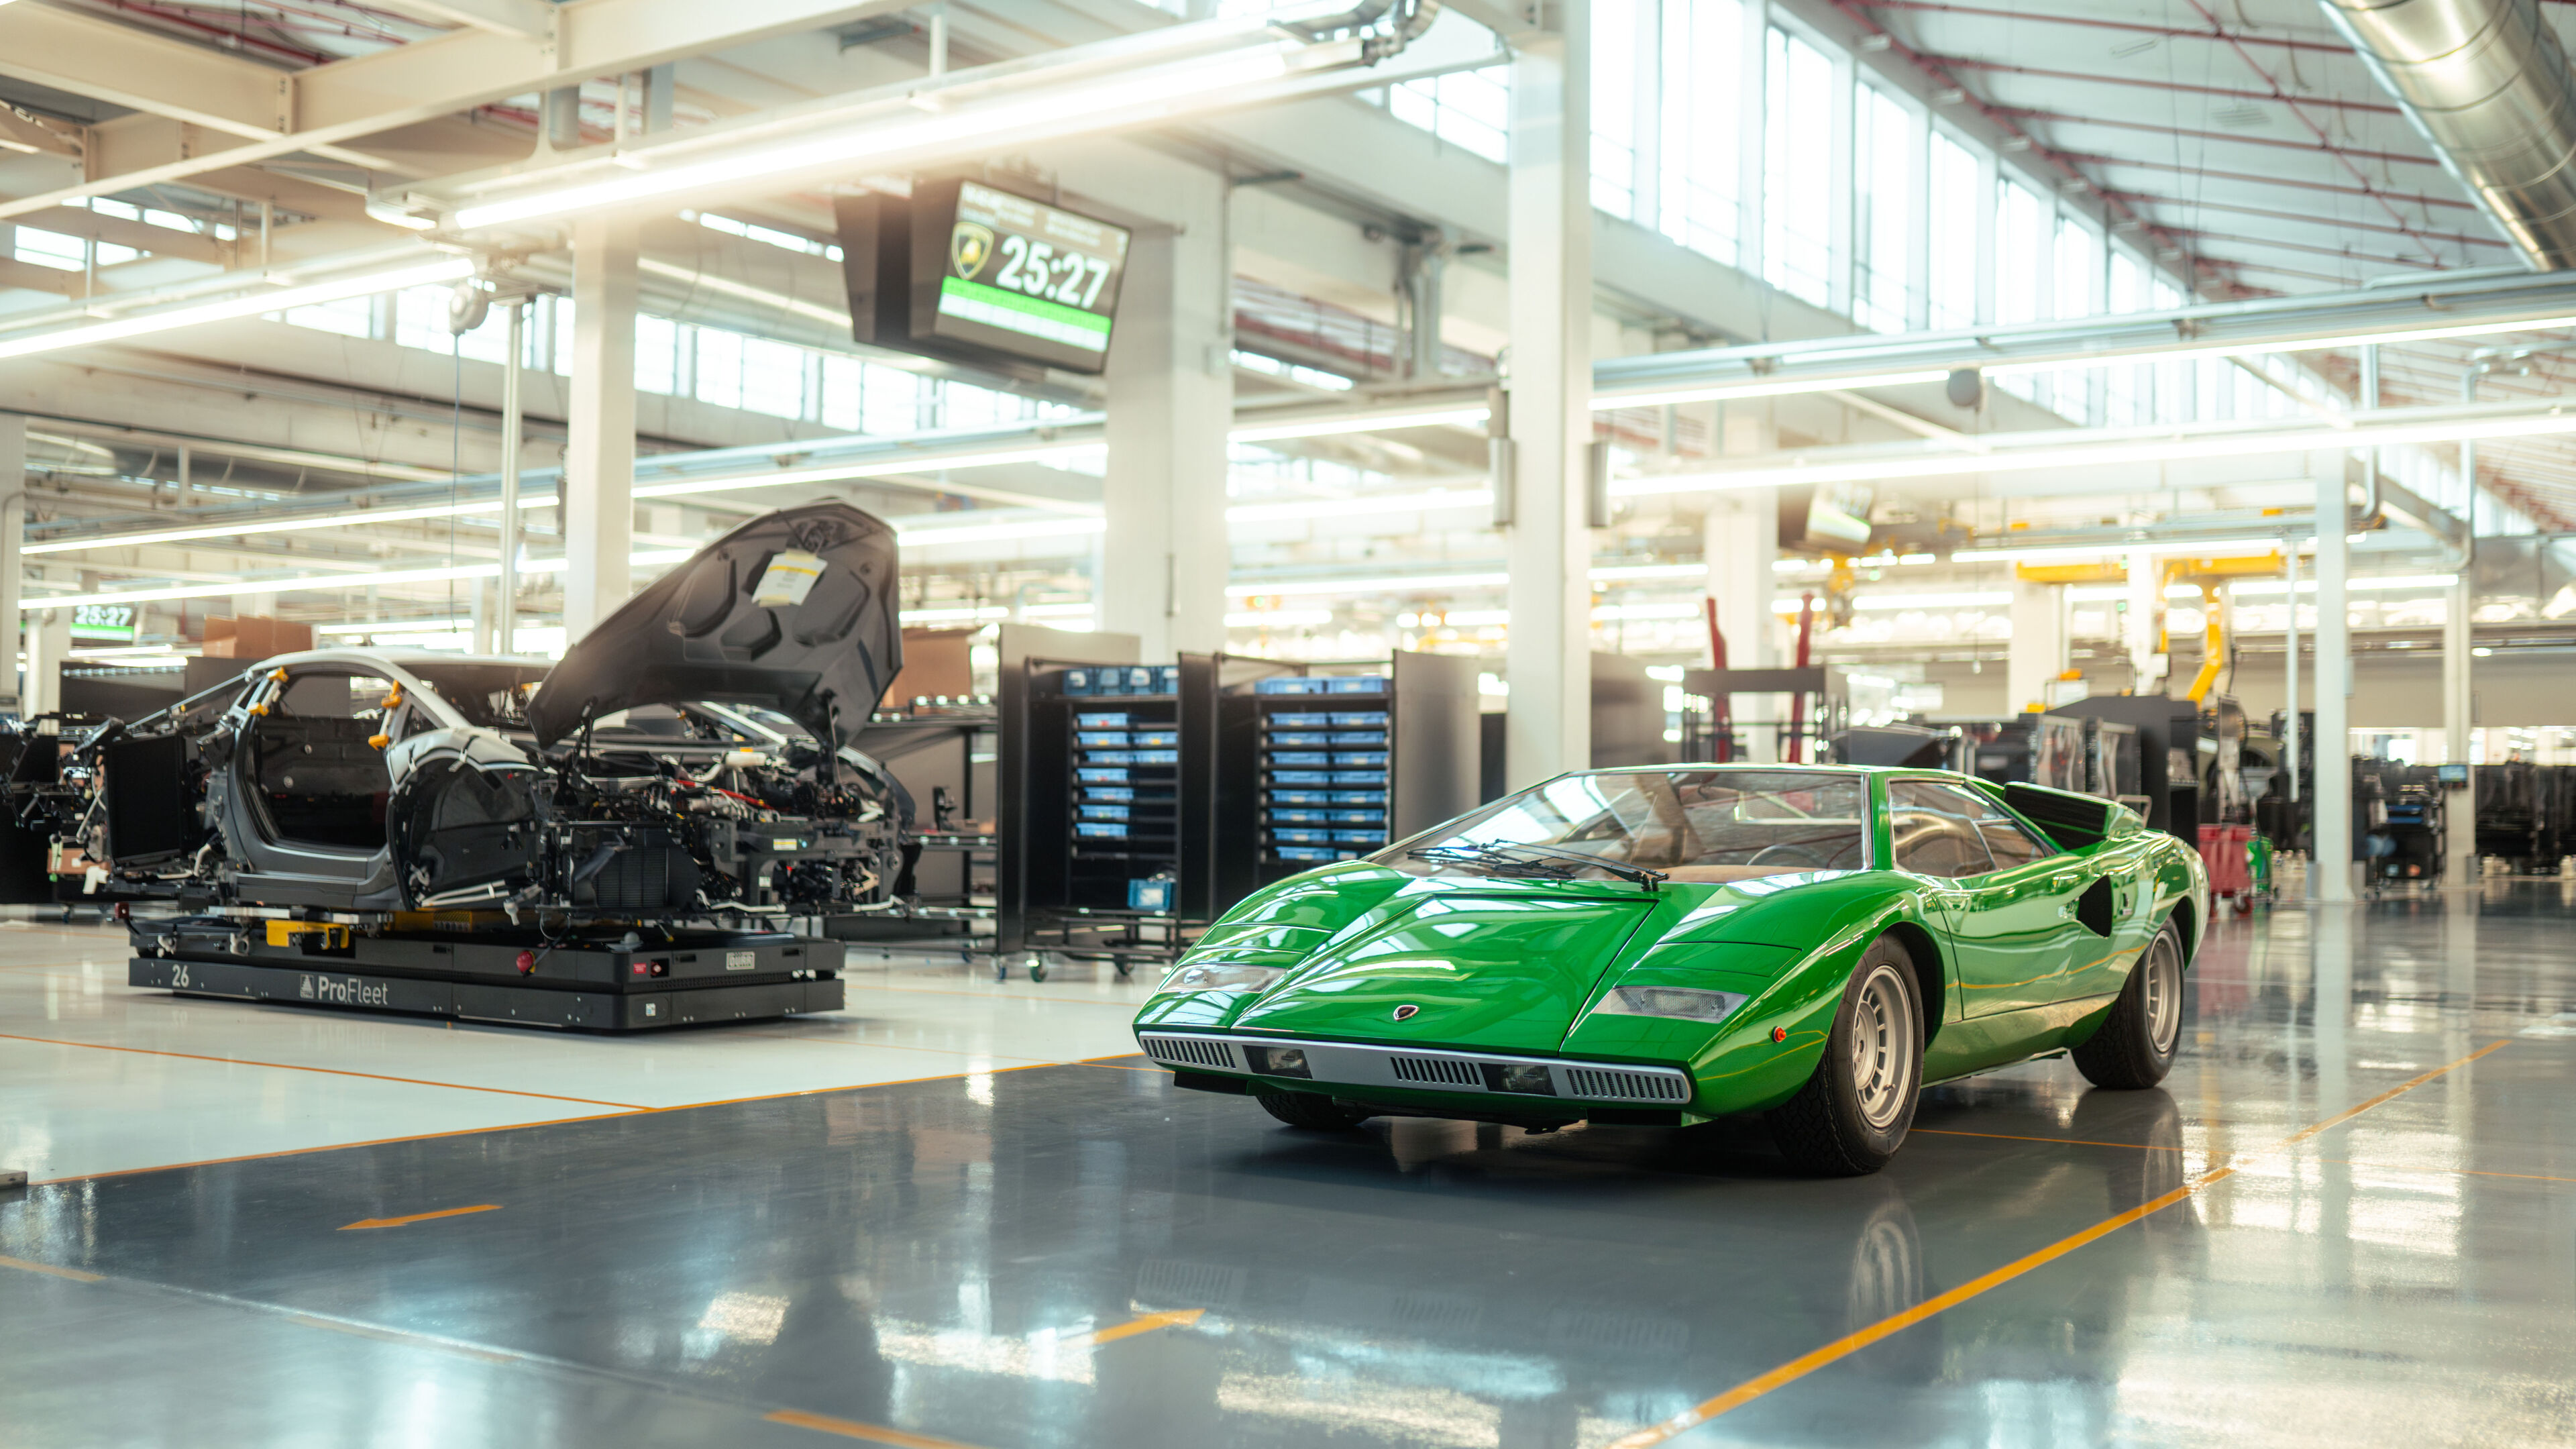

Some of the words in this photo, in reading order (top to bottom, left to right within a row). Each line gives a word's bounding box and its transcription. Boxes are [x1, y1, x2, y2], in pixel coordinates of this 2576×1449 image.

[996, 235, 1111, 309] 25:27
[172, 963, 189, 987] 26
[318, 975, 388, 1005] ProFleet
